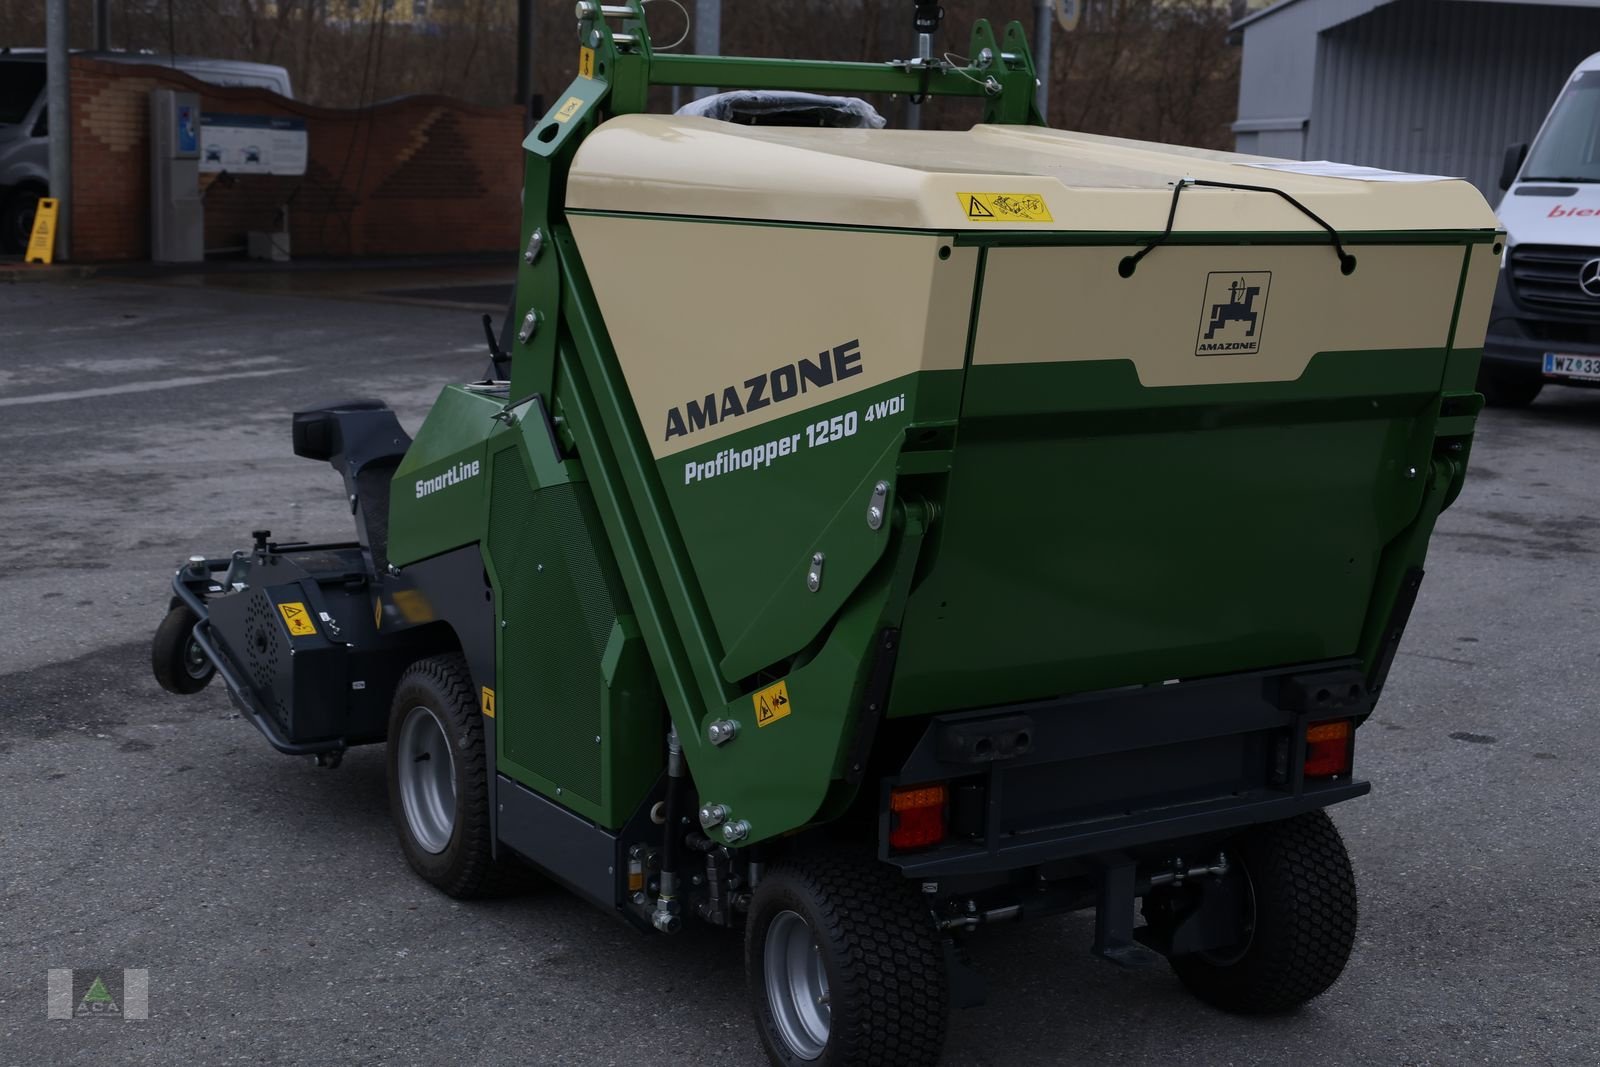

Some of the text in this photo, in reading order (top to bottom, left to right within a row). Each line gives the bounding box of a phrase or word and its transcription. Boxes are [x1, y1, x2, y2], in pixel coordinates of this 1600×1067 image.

[1198, 341, 1257, 351] AMAZONE
[664, 338, 863, 442] AMAZONE
[684, 393, 905, 485] Profihopper 1250 4WDi
[415, 459, 480, 499] SmartLine
